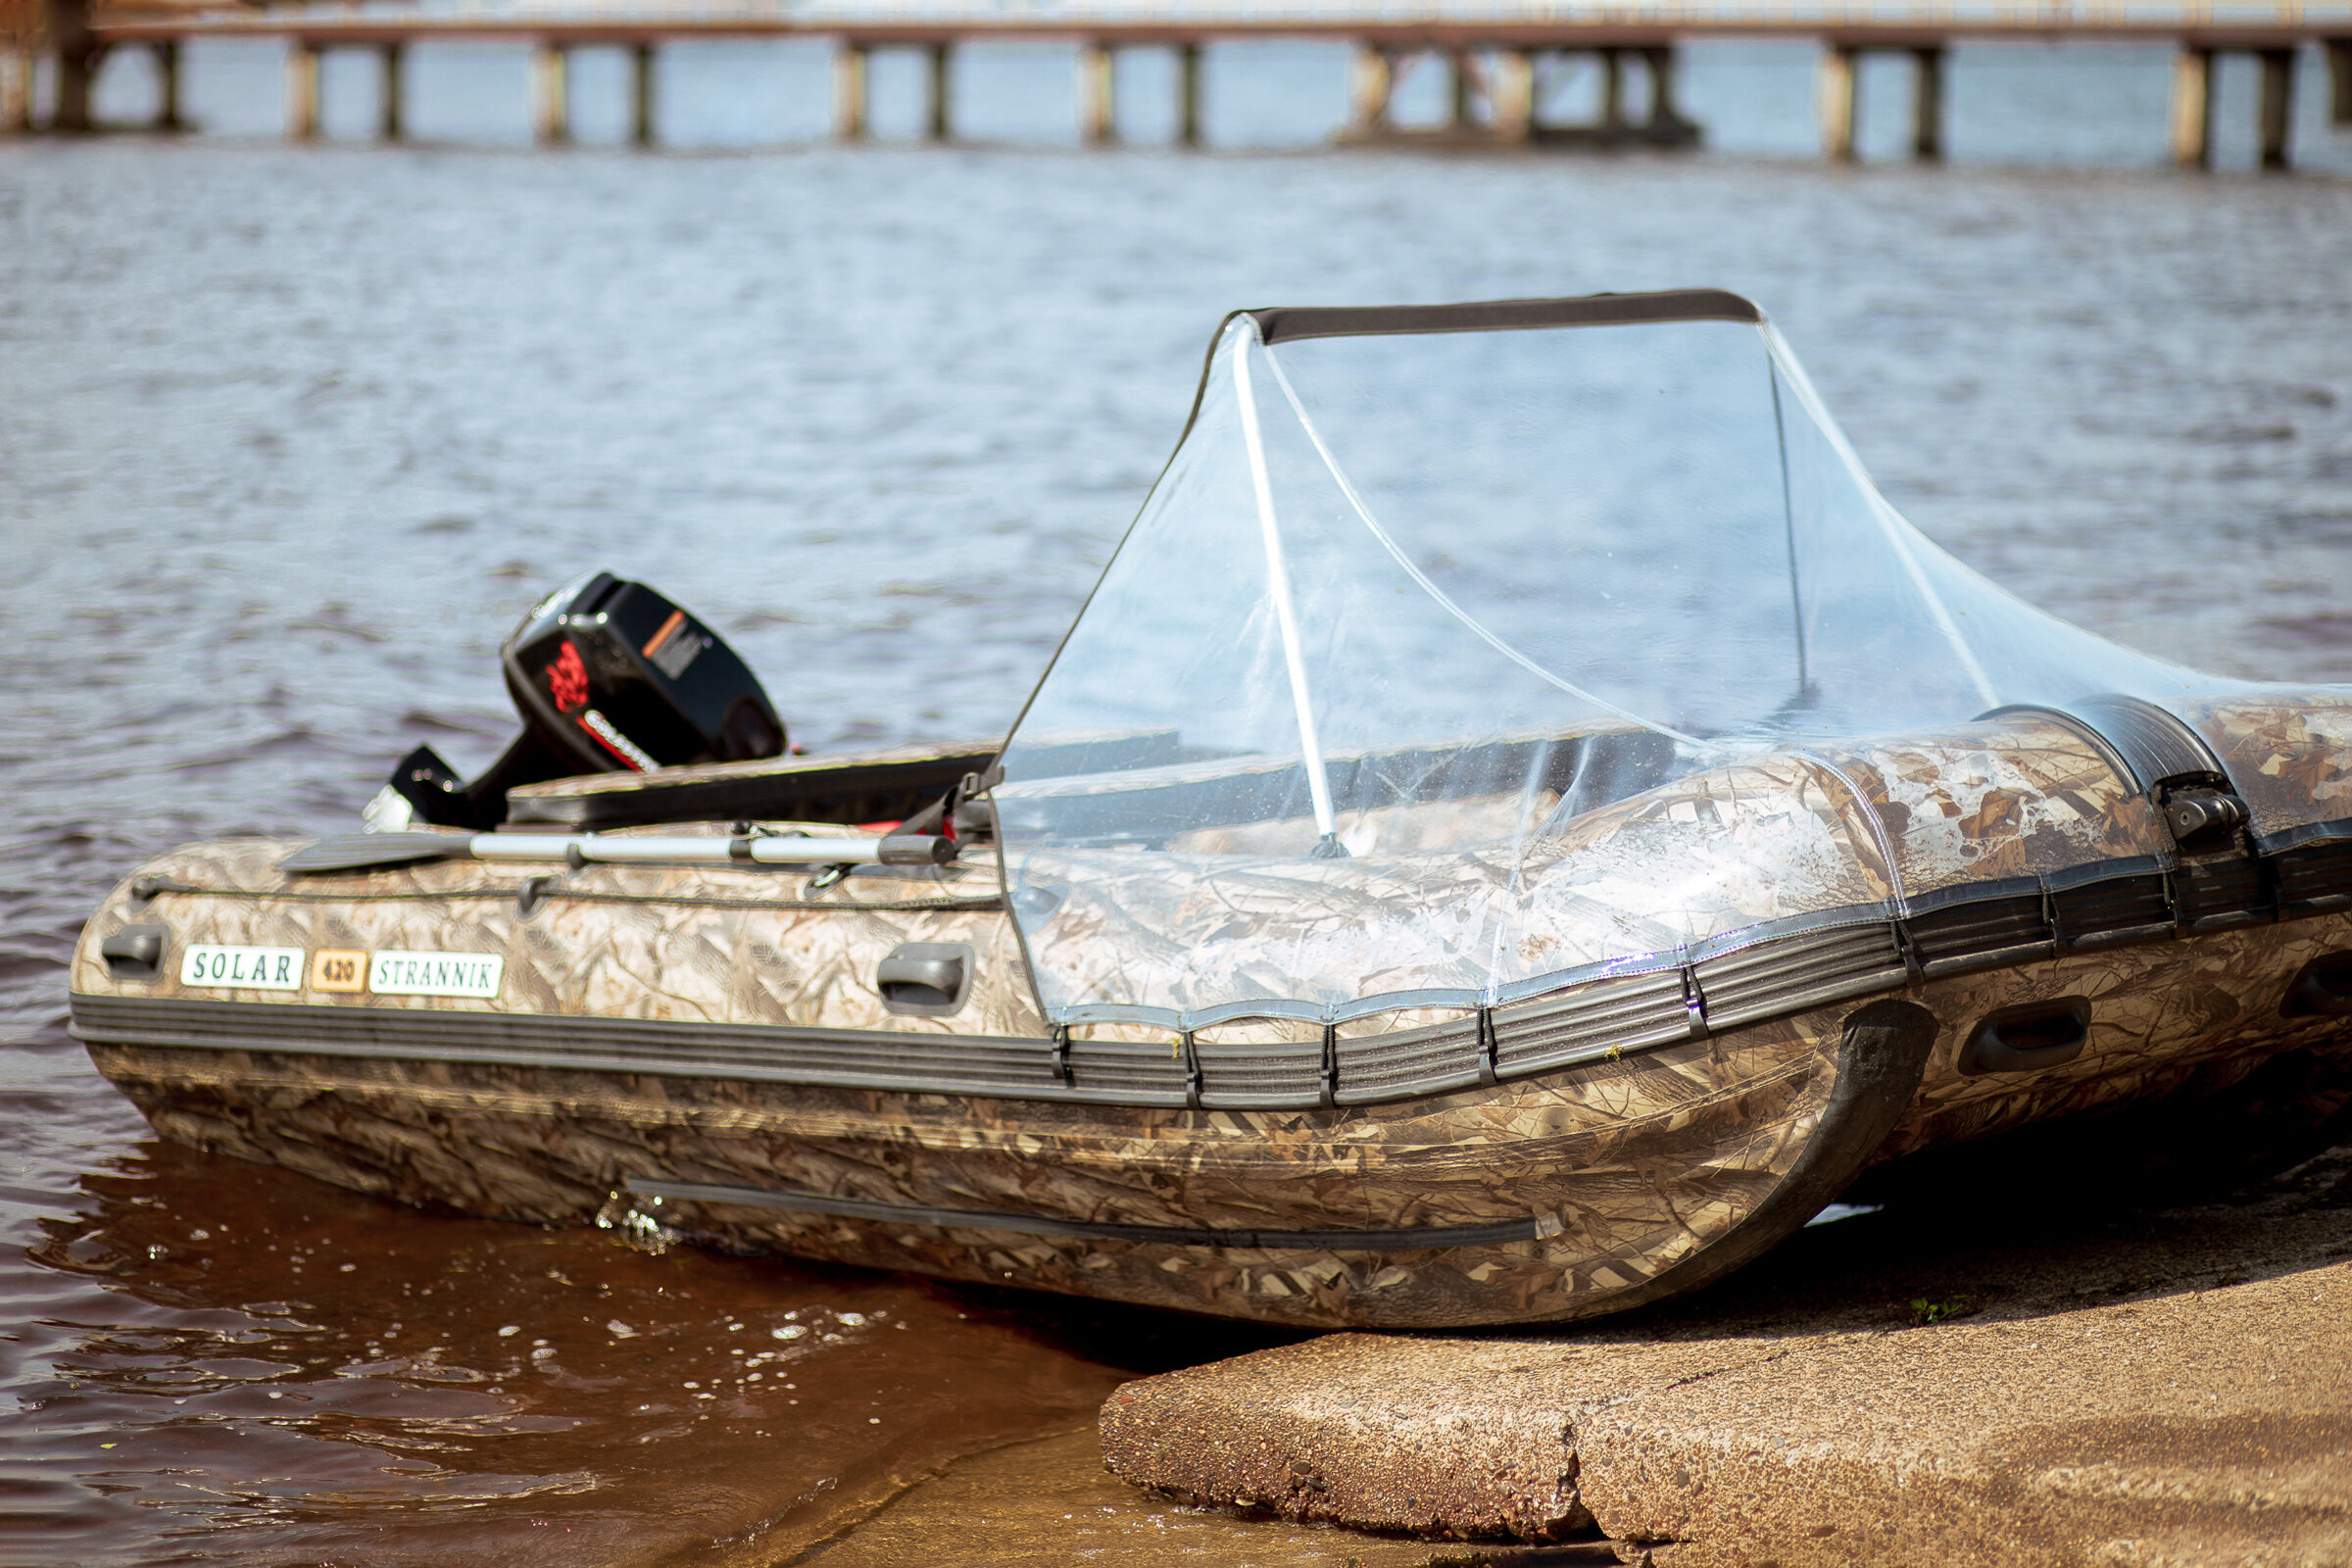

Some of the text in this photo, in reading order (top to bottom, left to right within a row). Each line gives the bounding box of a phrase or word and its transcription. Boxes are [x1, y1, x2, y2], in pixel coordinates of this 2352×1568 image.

[193, 952, 493, 989] SOLAR 420 STRANNIK
